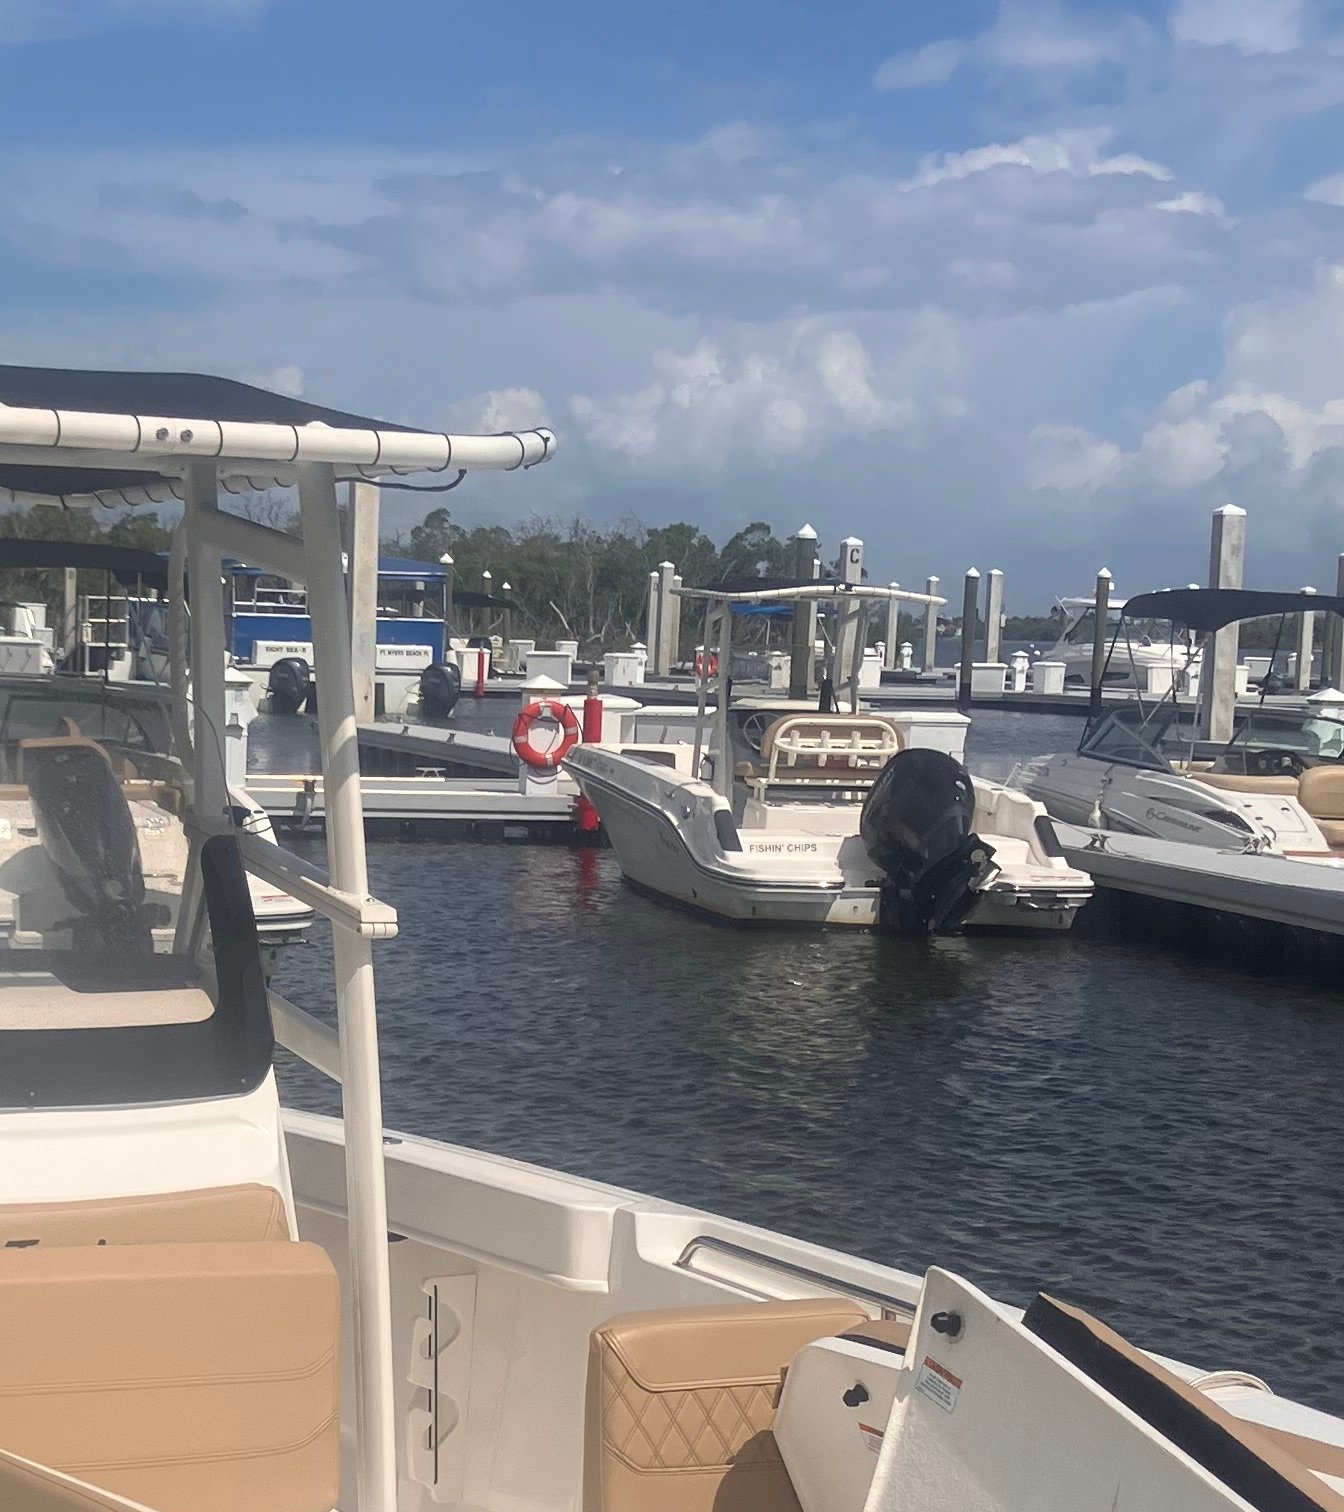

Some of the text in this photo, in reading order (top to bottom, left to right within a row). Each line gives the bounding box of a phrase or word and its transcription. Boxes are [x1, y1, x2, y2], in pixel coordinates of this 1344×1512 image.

[850, 548, 860, 564] C
[749, 843, 818, 853] FISHIN' CHIPS
